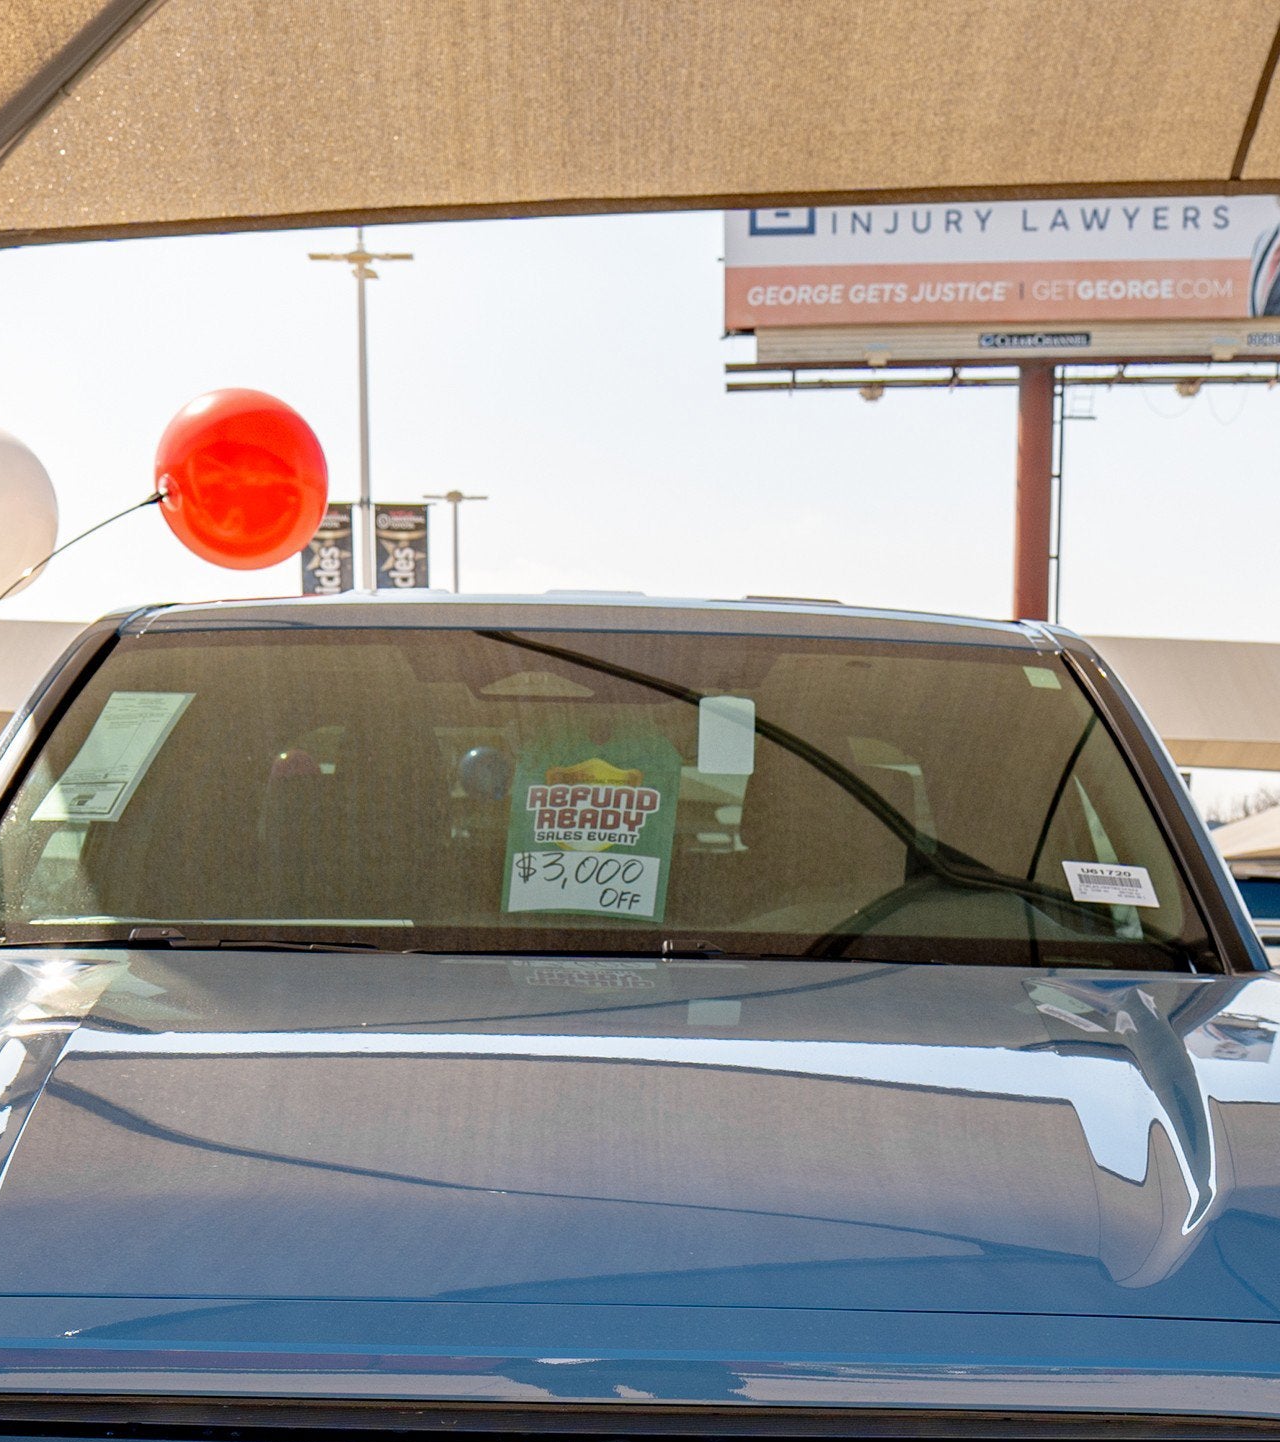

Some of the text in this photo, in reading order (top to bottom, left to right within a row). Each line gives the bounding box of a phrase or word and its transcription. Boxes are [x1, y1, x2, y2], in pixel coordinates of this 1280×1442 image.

[831, 204, 1231, 236] INJURY LAWYERS
[746, 284, 845, 307] GEORGE
[848, 282, 908, 305] GETS
[528, 785, 659, 812] REFUND
[536, 808, 644, 832] READY
[535, 830, 638, 845] SALES EVENT
[515, 852, 644, 889] $3,000
[599, 887, 641, 910] OFF
